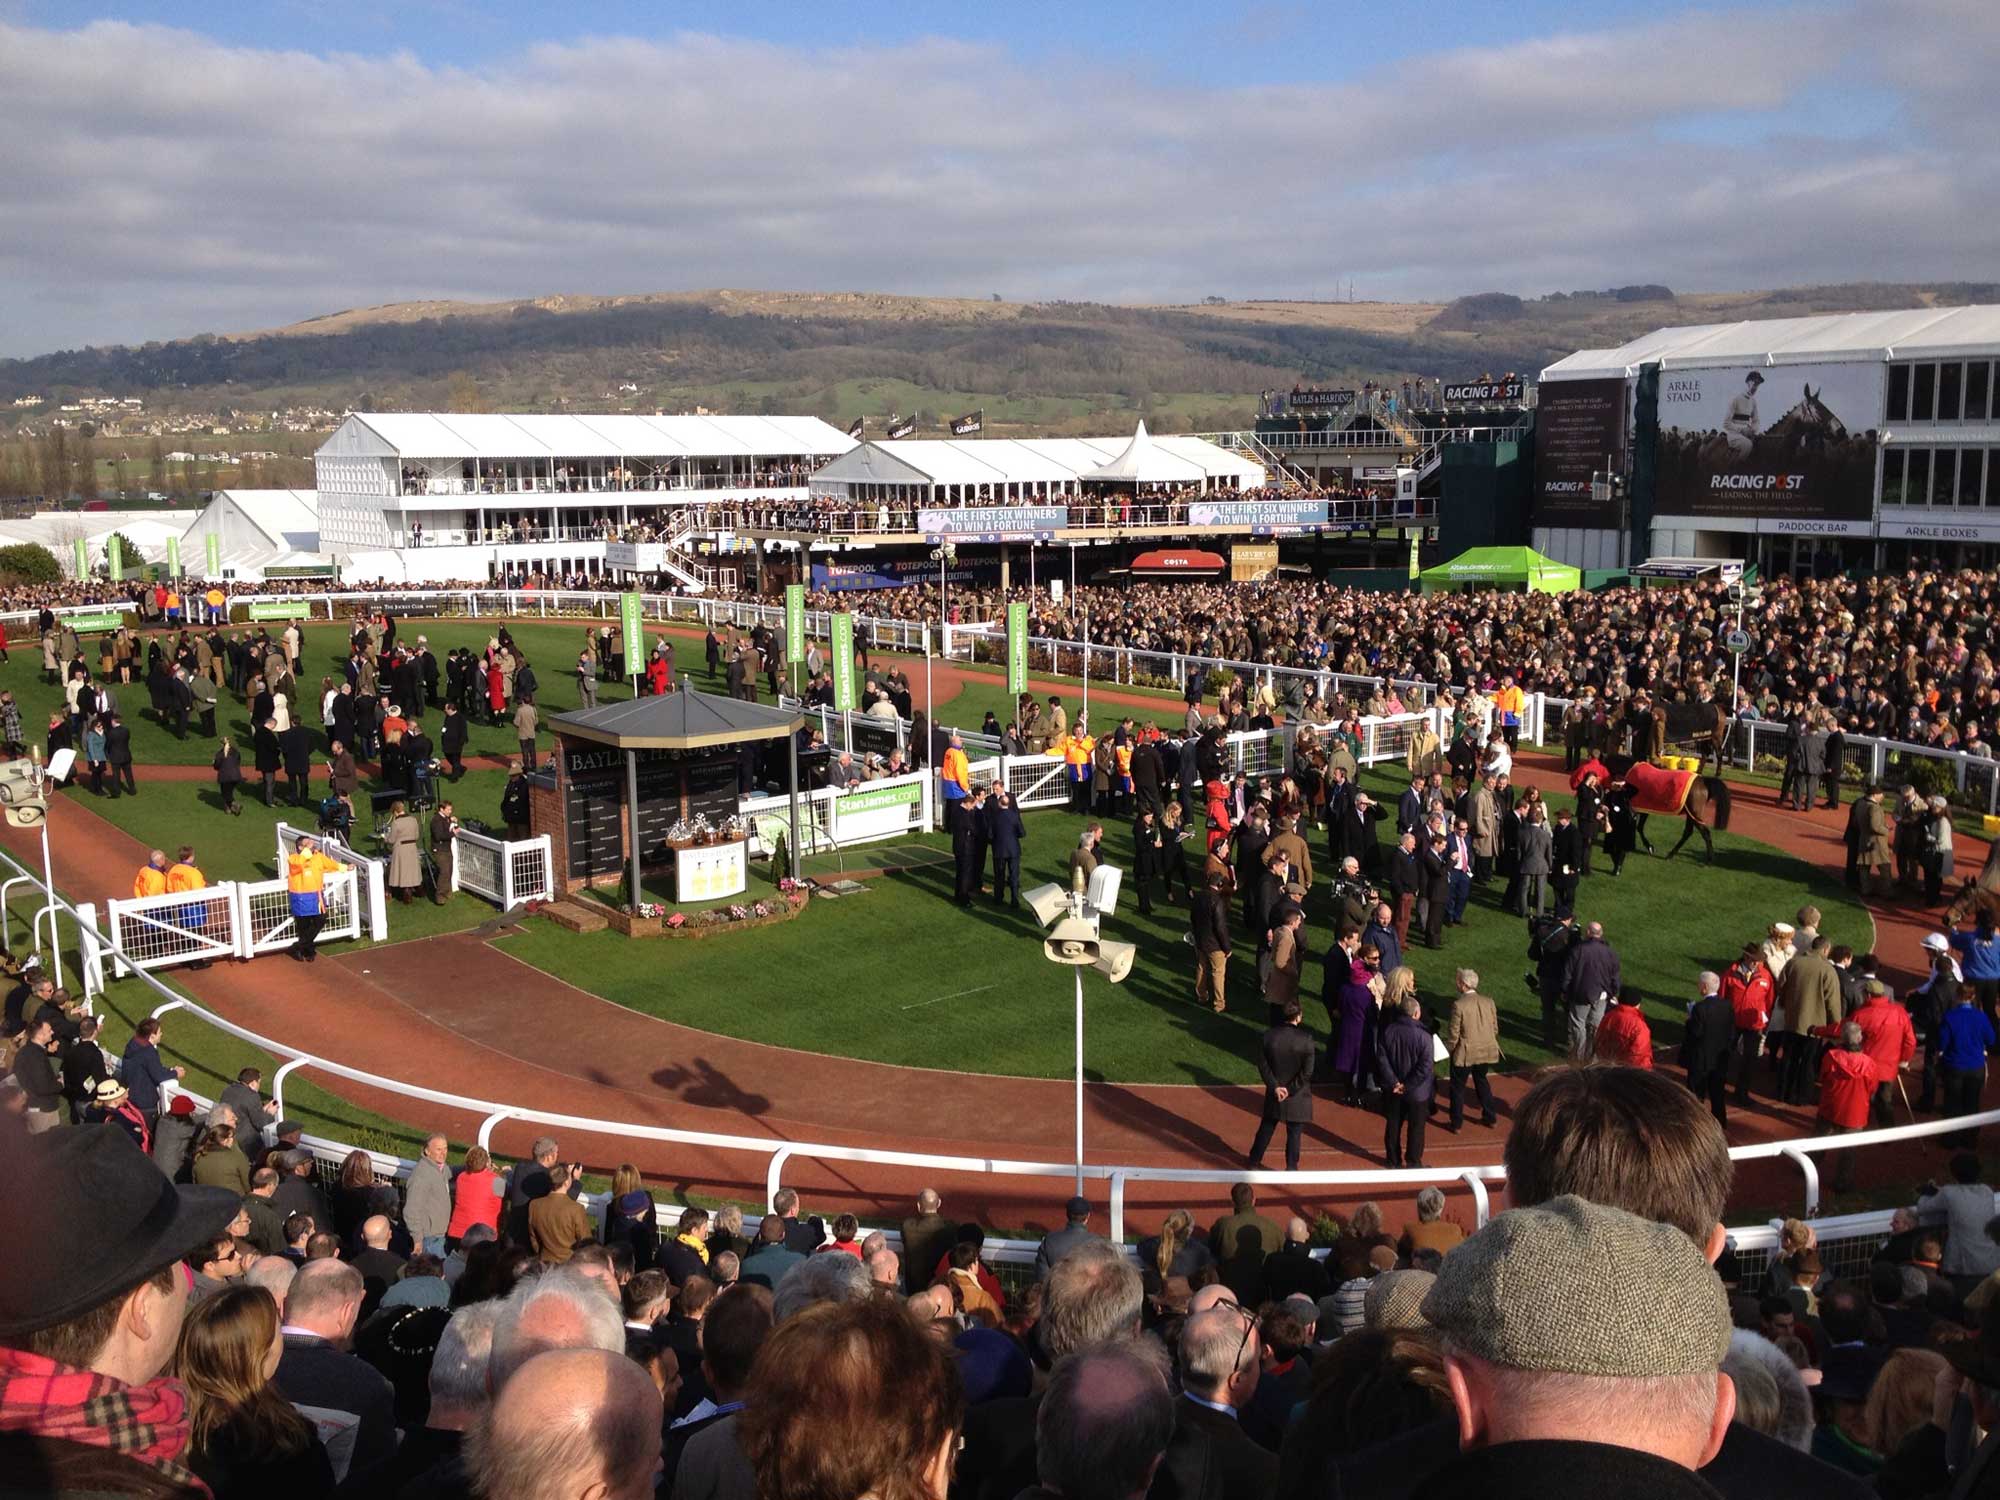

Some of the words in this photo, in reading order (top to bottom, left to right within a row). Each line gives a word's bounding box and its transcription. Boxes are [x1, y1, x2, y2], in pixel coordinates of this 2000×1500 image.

[1668, 380, 1700, 391] ARKLE
[1446, 386, 1489, 400] RACING
[1490, 384, 1521, 398] POST
[1666, 391, 1701, 402] STAND
[1545, 481, 1577, 491] RACING
[1577, 481, 1593, 491] POS
[1710, 474, 1764, 489] RACING
[1765, 474, 1805, 490] POST
[1720, 490, 1753, 500] LEADING
[1755, 491, 1769, 500] THE
[1771, 491, 1793, 500] FIELD
[1219, 504, 1236, 514] THE
[1238, 504, 1262, 514] FIRST
[1263, 503, 1278, 513] SIX
[1278, 502, 1319, 513] WINNERS
[950, 510, 969, 521] THE
[970, 510, 997, 521] FIRST
[998, 509, 1014, 520] SIX
[1014, 508, 1057, 519] WINNERS
[1220, 514, 1231, 524] TO
[1231, 514, 1250, 524] WIN
[1251, 513, 1258, 524] A
[1259, 513, 1299, 523] FORTUNE
[786, 518, 810, 529] RACING
[810, 518, 830, 529] POST
[951, 522, 962, 532] TO
[964, 521, 984, 531] WIN
[985, 520, 992, 531] A
[993, 520, 1036, 530] FORTUNE
[1777, 521, 1825, 532] PADDOCK
[1827, 522, 1848, 533] BAR
[1002, 532, 1036, 541] TOTEPOOL
[1905, 526, 1939, 537] ARKLE
[1942, 527, 1979, 538] BOXES
[947, 534, 981, 543] TOTEPOOL
[828, 564, 877, 576] TOTEPOOL
[896, 560, 940, 571] TOTEPOOL
[903, 574, 921, 584] MAKE
[921, 573, 928, 583] IT
[946, 571, 974, 581] EXCITING
[792, 587, 801, 659] StanJames.com
[628, 595, 641, 672] StanJames.com
[1014, 607, 1024, 690] StanJames.com
[839, 617, 851, 706] StanJames.com
[571, 750, 629, 771] BAYLI
[839, 788, 920, 812] StanJames.com
